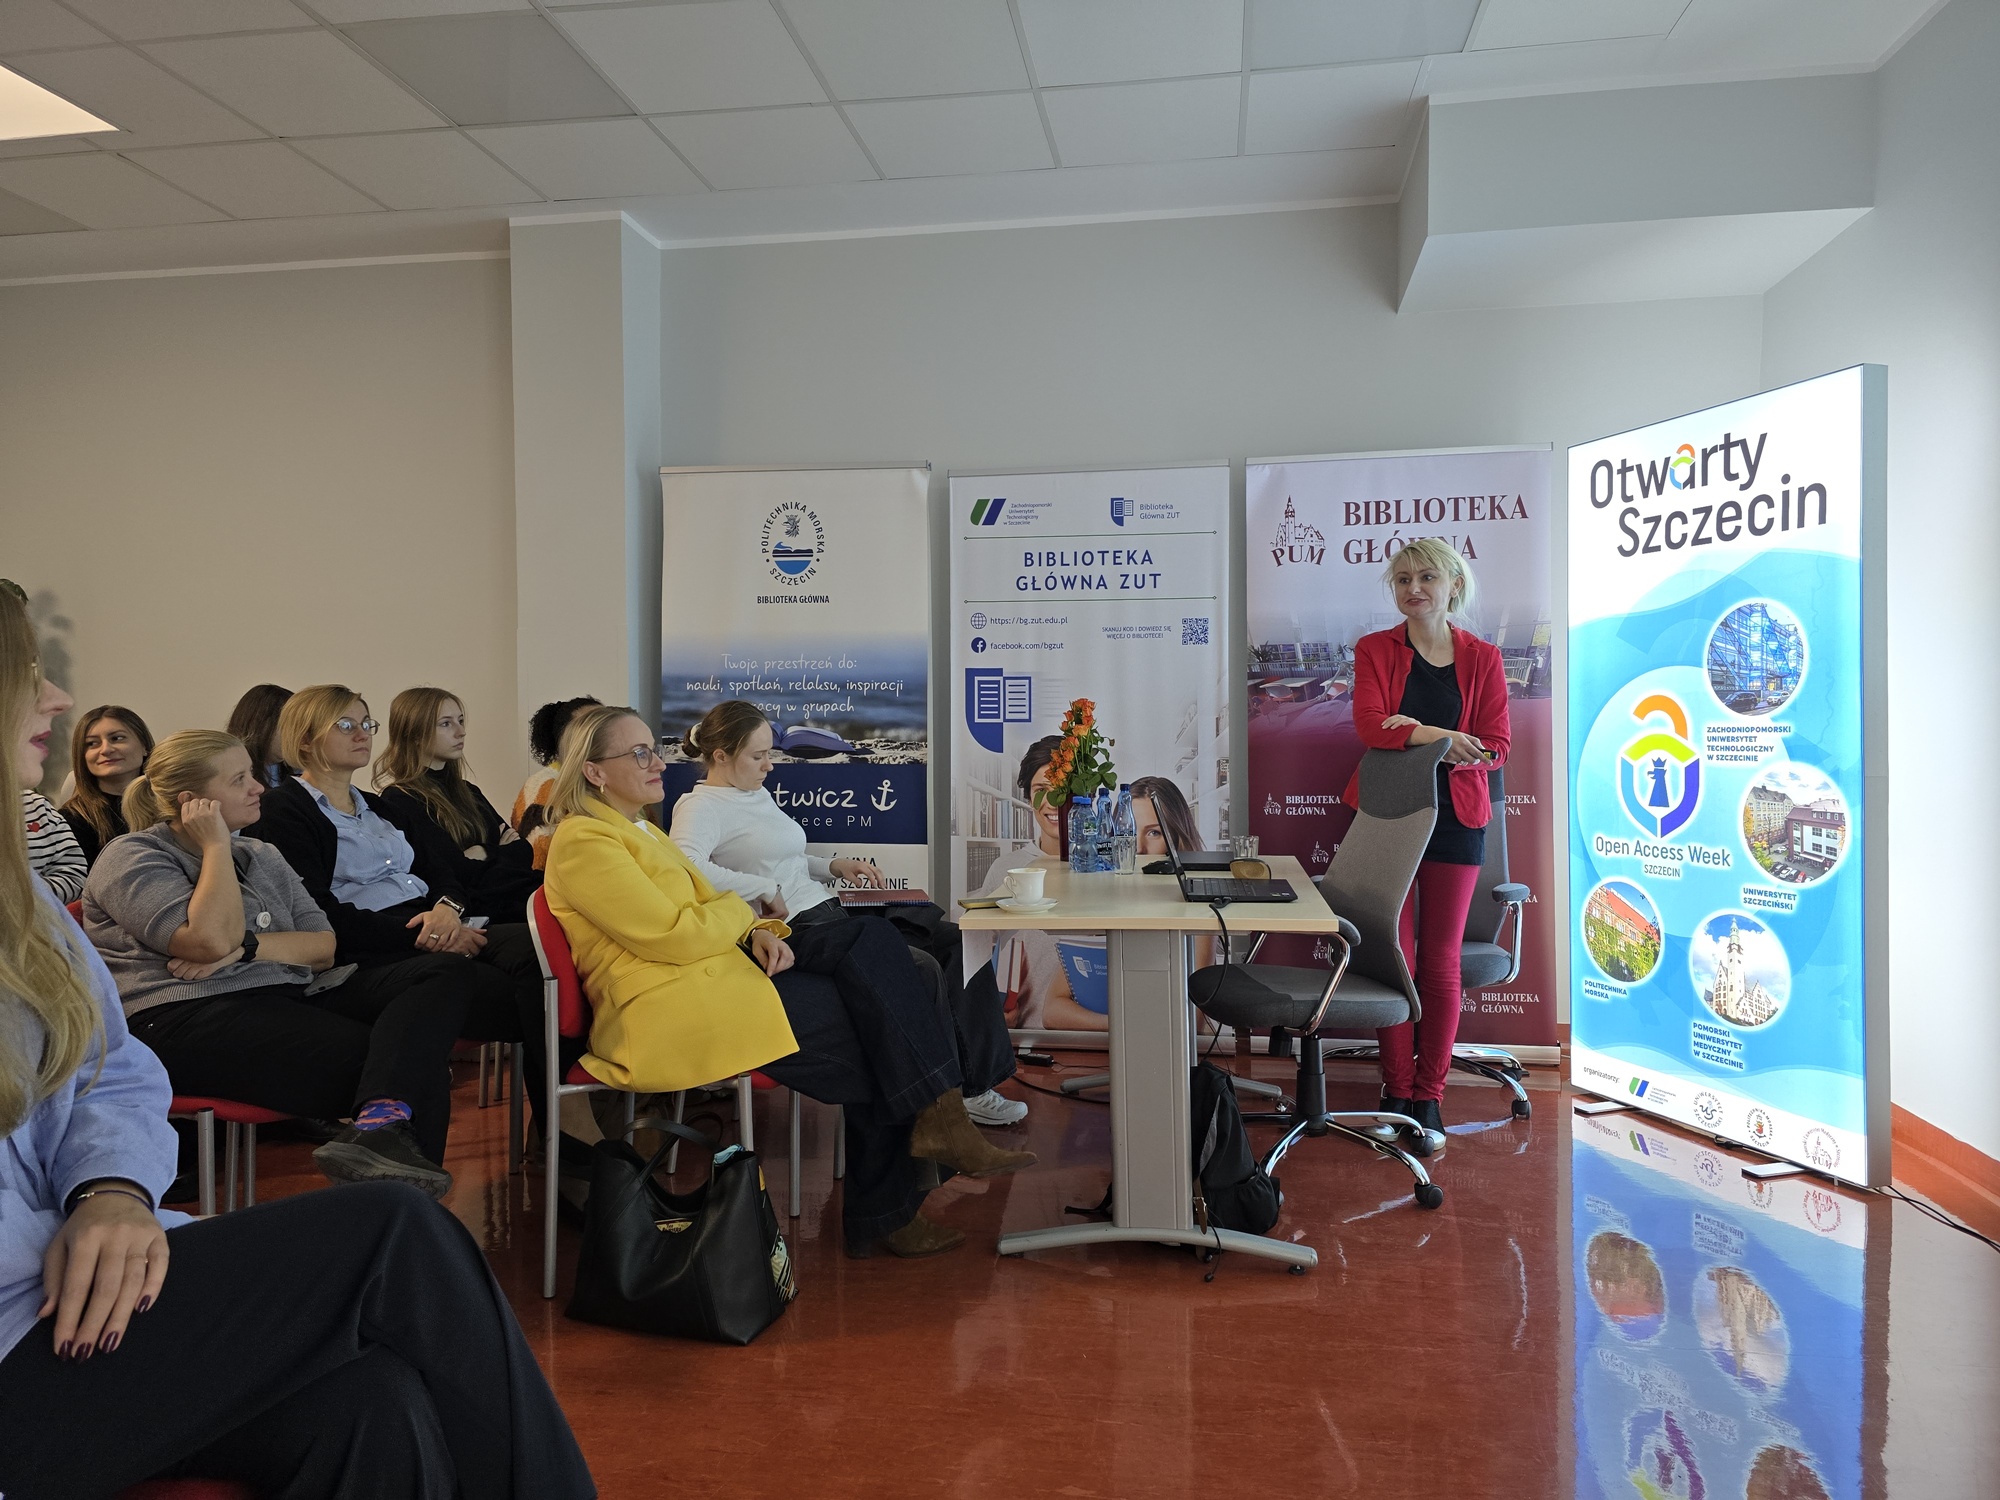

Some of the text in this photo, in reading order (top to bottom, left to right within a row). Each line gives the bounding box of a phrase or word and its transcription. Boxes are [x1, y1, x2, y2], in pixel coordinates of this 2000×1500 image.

[1590, 432, 1768, 509] Otwarty
[1139, 503, 1174, 511] Biblioteka
[1343, 494, 1529, 526] BIBLIOTEKA
[1139, 511, 1180, 520] Główna ZUT
[1617, 473, 1827, 557] Szczecin
[761, 501, 825, 554] POLITECHNIKA MORSKA
[1024, 550, 1153, 567] BIBLIOTEKA
[1270, 545, 1326, 568] PUM
[769, 567, 817, 586] SZCZECIN
[1016, 571, 1161, 591] GŁÓWNA ZUT
[757, 594, 830, 604] BIBLIOTEKA GŁÓWNA
[990, 616, 1068, 626] https://bg.zut.edu.pl
[990, 642, 1064, 650] facebook.com/bgzut
[720, 653, 857, 675] Twoja przestrzeń do:
[686, 674, 903, 697] nauki, spotkań, relaksu, inspiracji
[786, 704, 796, 712] w
[802, 696, 855, 719] grupach
[1706, 725, 1791, 733] ZACHODNIOPOMORSKI
[1706, 735, 1758, 743] UNIWERSYTET
[1716, 754, 1759, 762] SZCZECINIE
[773, 782, 857, 807] twicz
[1285, 795, 1340, 804] BIBLIOTEKA
[1504, 795, 1537, 804] OTEKA
[1263, 807, 1281, 816] PUM
[1285, 804, 1326, 816] GŁÓWNA
[847, 815, 872, 827] PM
[1596, 836, 1731, 867] Open Access Week
[1311, 855, 1329, 864] PUM
[1644, 864, 1681, 878] SZCZECIN
[1743, 887, 1797, 901] UNIWERSYTET
[1743, 897, 1793, 910] SZCZECIŃSKI
[1584, 979, 1628, 996] POLITECHNIKA
[1584, 988, 1610, 999] MORSKA
[1481, 992, 1540, 1003] BIBLIOTEKA
[1481, 1002, 1524, 1014] GŁÓWNA
[1693, 1022, 1730, 1038] POMORSKI
[1693, 1031, 1743, 1050] UNIWERSYTET
[1693, 1040, 1732, 1056] MEDYCZNY
[1693, 1049, 1744, 1070] W SZCZECINIE
[1811, 1155, 1832, 1170] PUM
